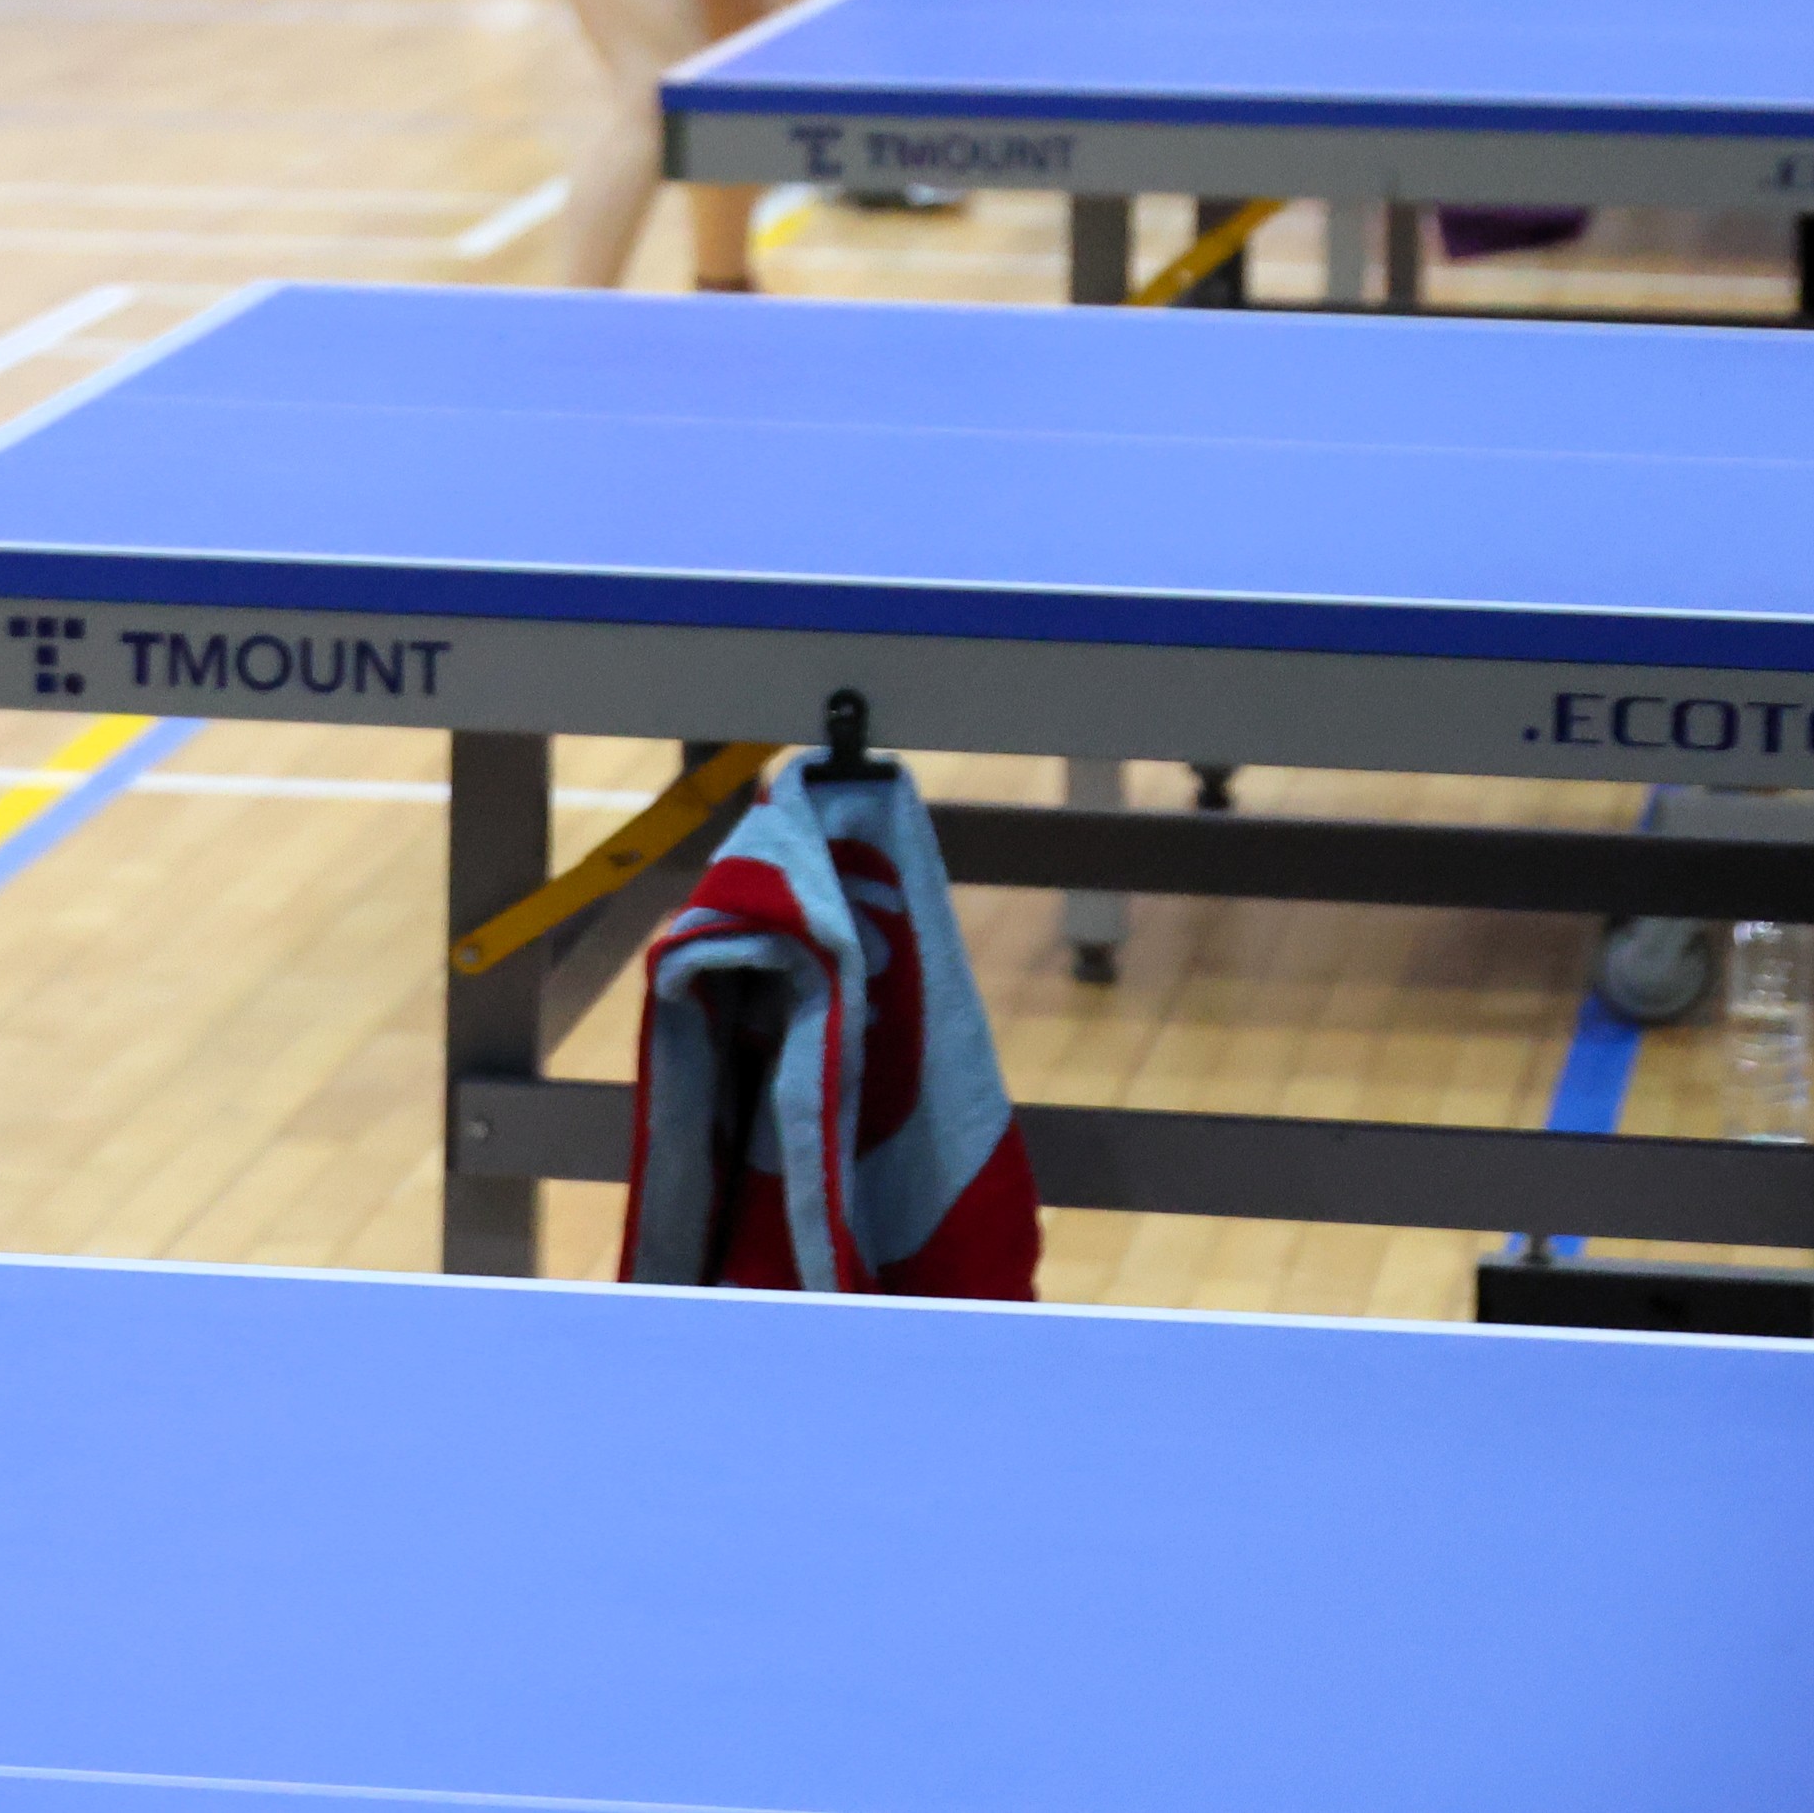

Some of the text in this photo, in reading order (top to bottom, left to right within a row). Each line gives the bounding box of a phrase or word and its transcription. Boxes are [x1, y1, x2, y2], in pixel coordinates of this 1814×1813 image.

[868, 133, 1075, 173] TMOUNT
[120, 630, 451, 695] TMOUNT
[1523, 691, 1814, 754] .ECOT
